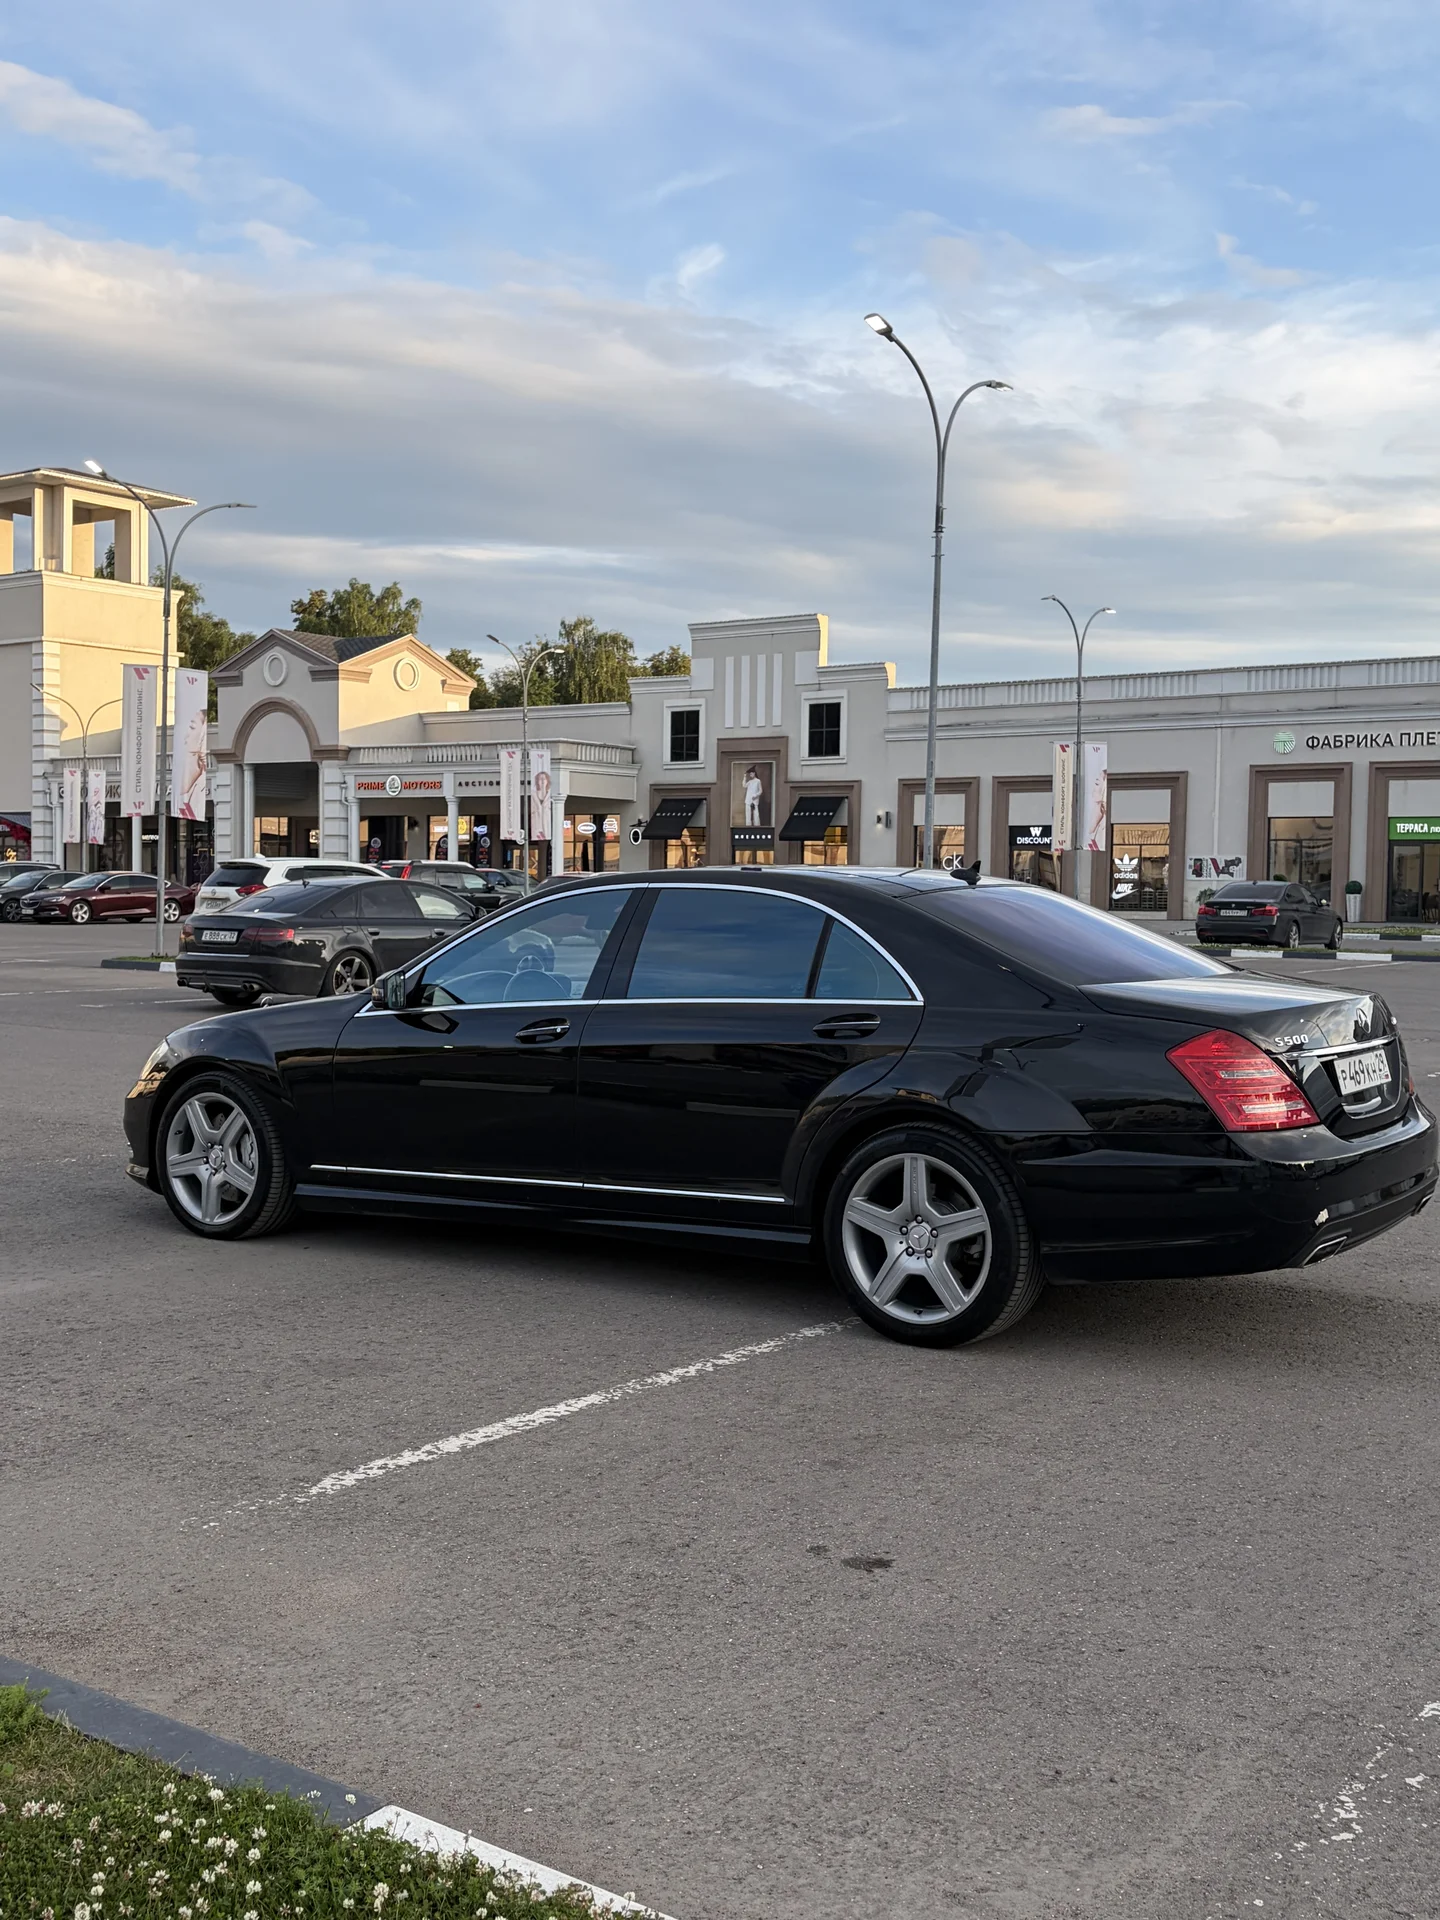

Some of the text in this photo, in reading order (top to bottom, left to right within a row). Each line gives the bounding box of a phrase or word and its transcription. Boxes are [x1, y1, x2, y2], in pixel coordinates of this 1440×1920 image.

[1305, 731, 1440, 750] ФАБРИКА ПЛЕ
[356, 780, 442, 791] PRIME MOTORS
[1396, 823, 1429, 834] ТЕРРАСА
[1113, 871, 1139, 879] adidas
[1115, 883, 1134, 892] NIKE
